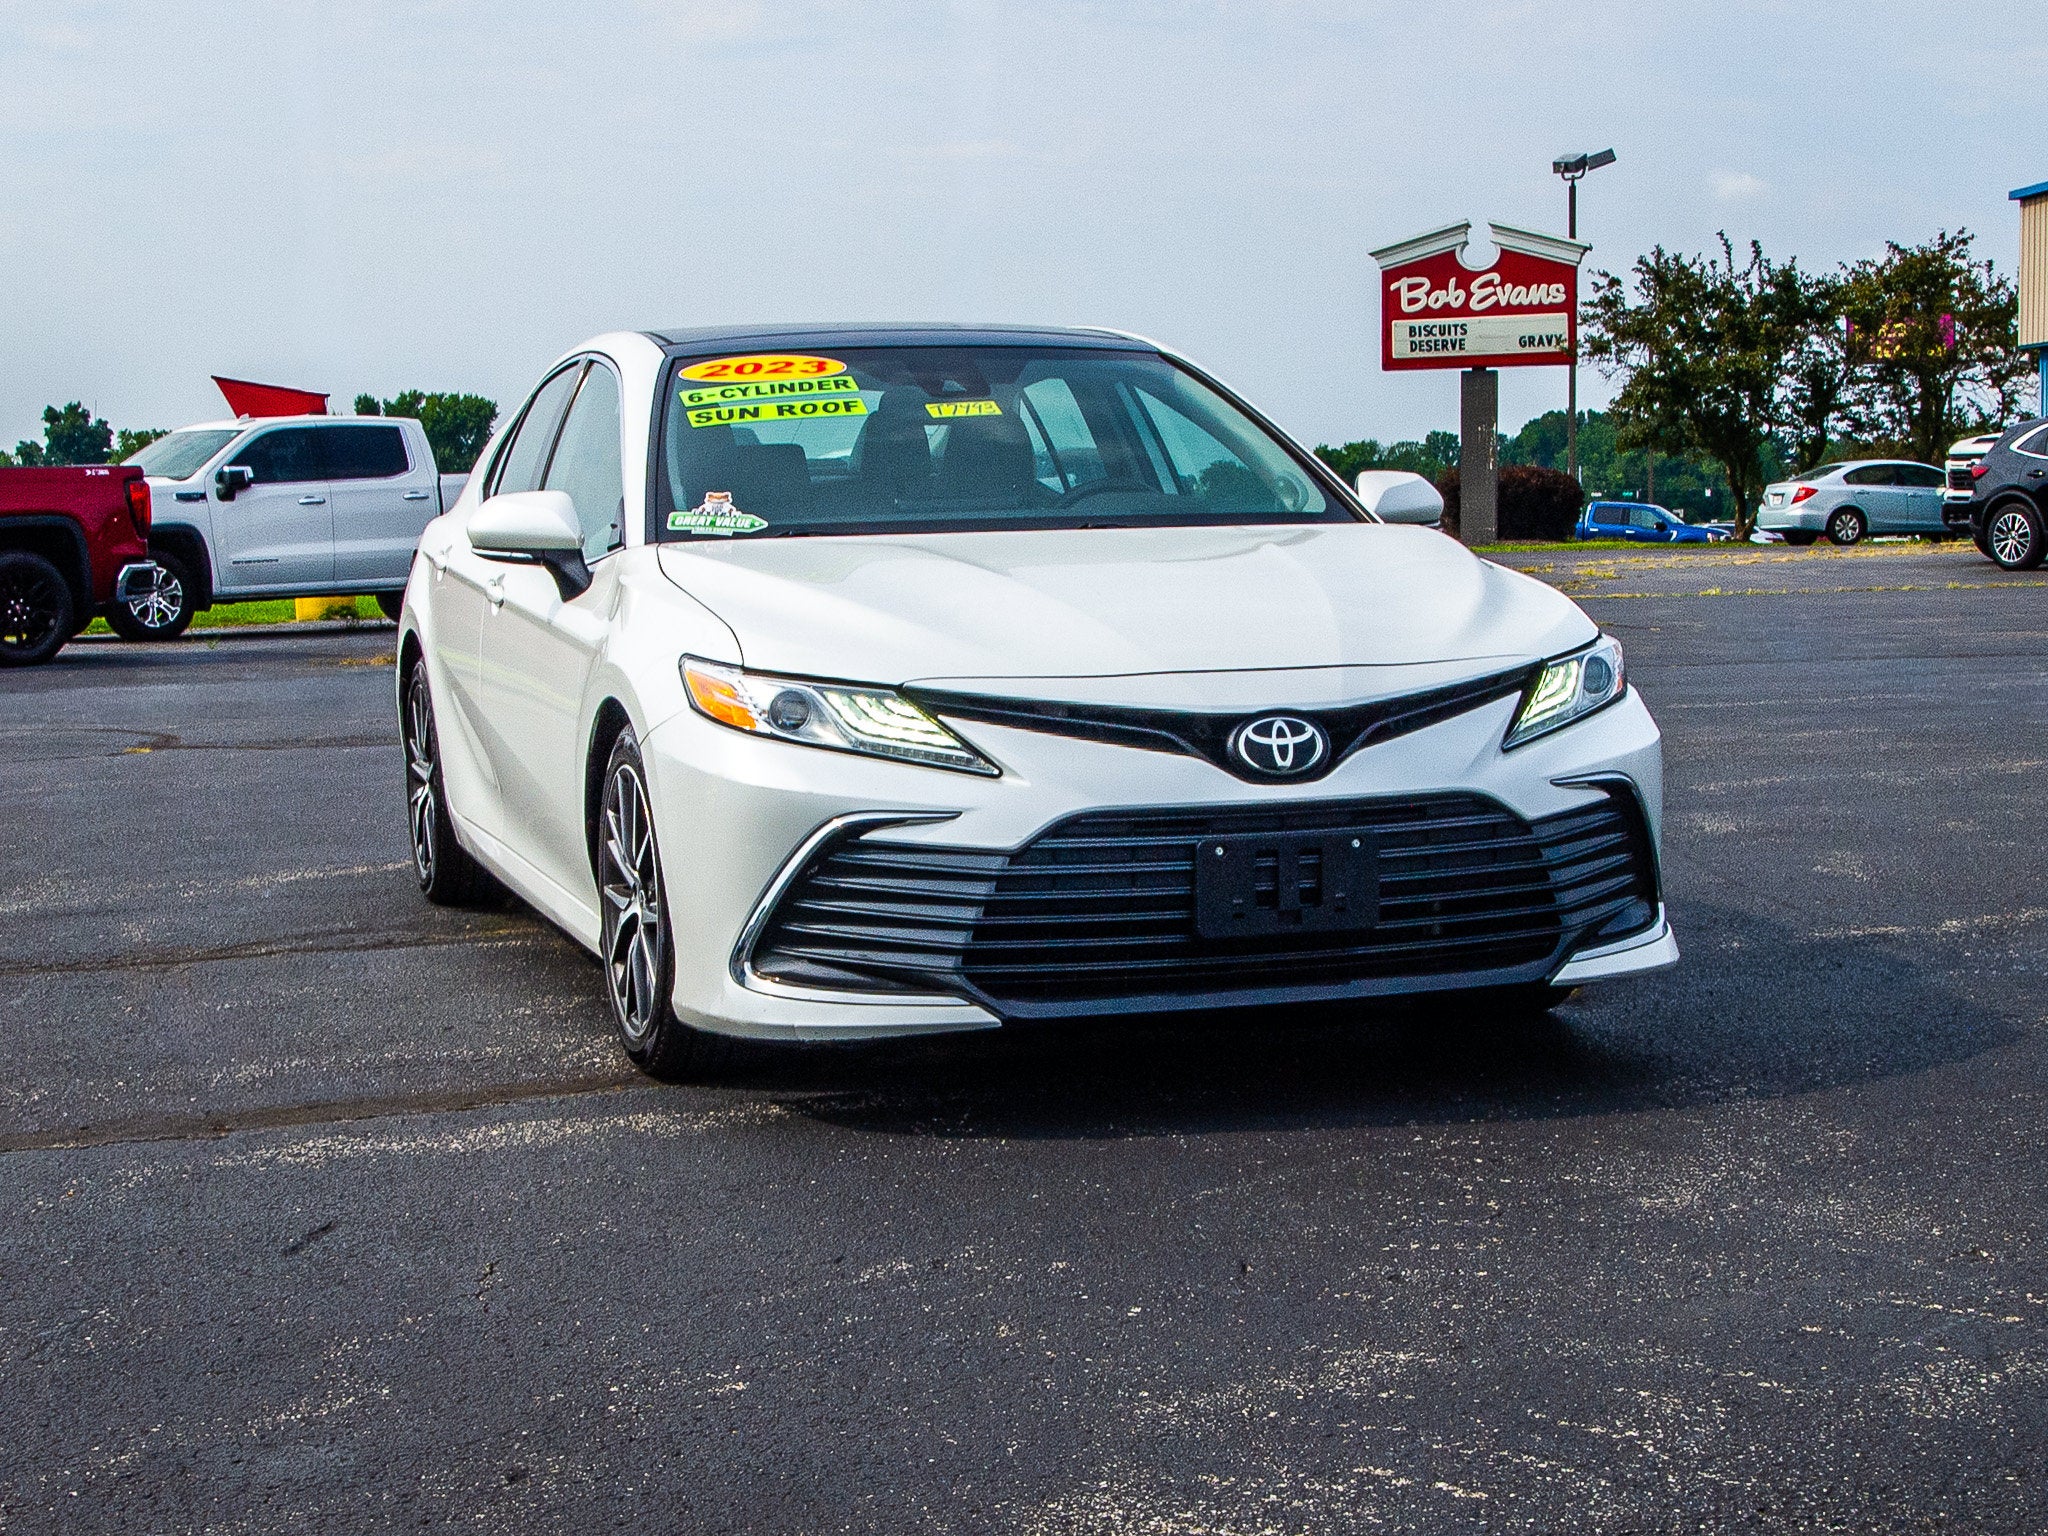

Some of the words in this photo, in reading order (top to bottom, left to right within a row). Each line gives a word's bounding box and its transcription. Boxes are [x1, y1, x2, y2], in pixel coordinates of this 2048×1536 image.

[1390, 276, 1466, 313] Bob
[1469, 272, 1566, 311] Evans
[1408, 323, 1468, 338] BISCUITS
[1409, 338, 1466, 353] DESERVE
[1518, 334, 1563, 348] GRAVY
[700, 360, 828, 379] 2023
[688, 379, 853, 403] 6-CYLINDER
[694, 406, 760, 424] SUN
[776, 400, 859, 417] ROOF
[674, 515, 714, 527] GREAT
[715, 516, 752, 529] VALUE
